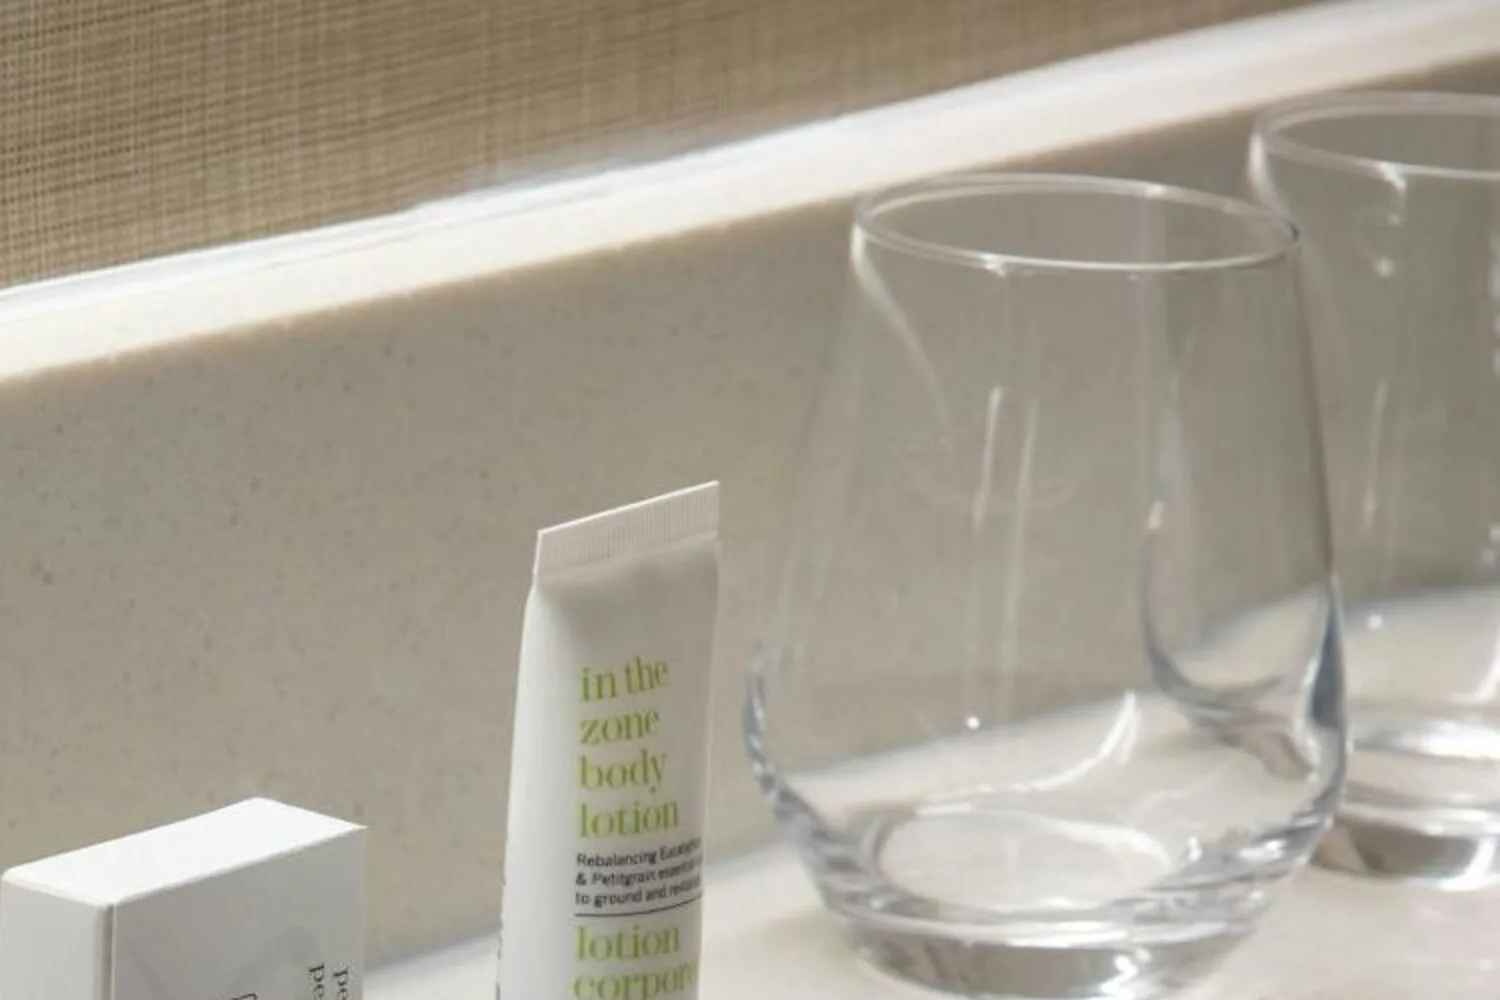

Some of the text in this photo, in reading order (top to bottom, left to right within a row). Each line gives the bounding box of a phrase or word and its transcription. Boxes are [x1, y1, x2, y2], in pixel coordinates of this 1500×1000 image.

[582, 656, 669, 701] in the
[580, 707, 659, 745] zone
[580, 749, 666, 793] body
[580, 801, 679, 837] lotion
[575, 925, 679, 961] lotion
